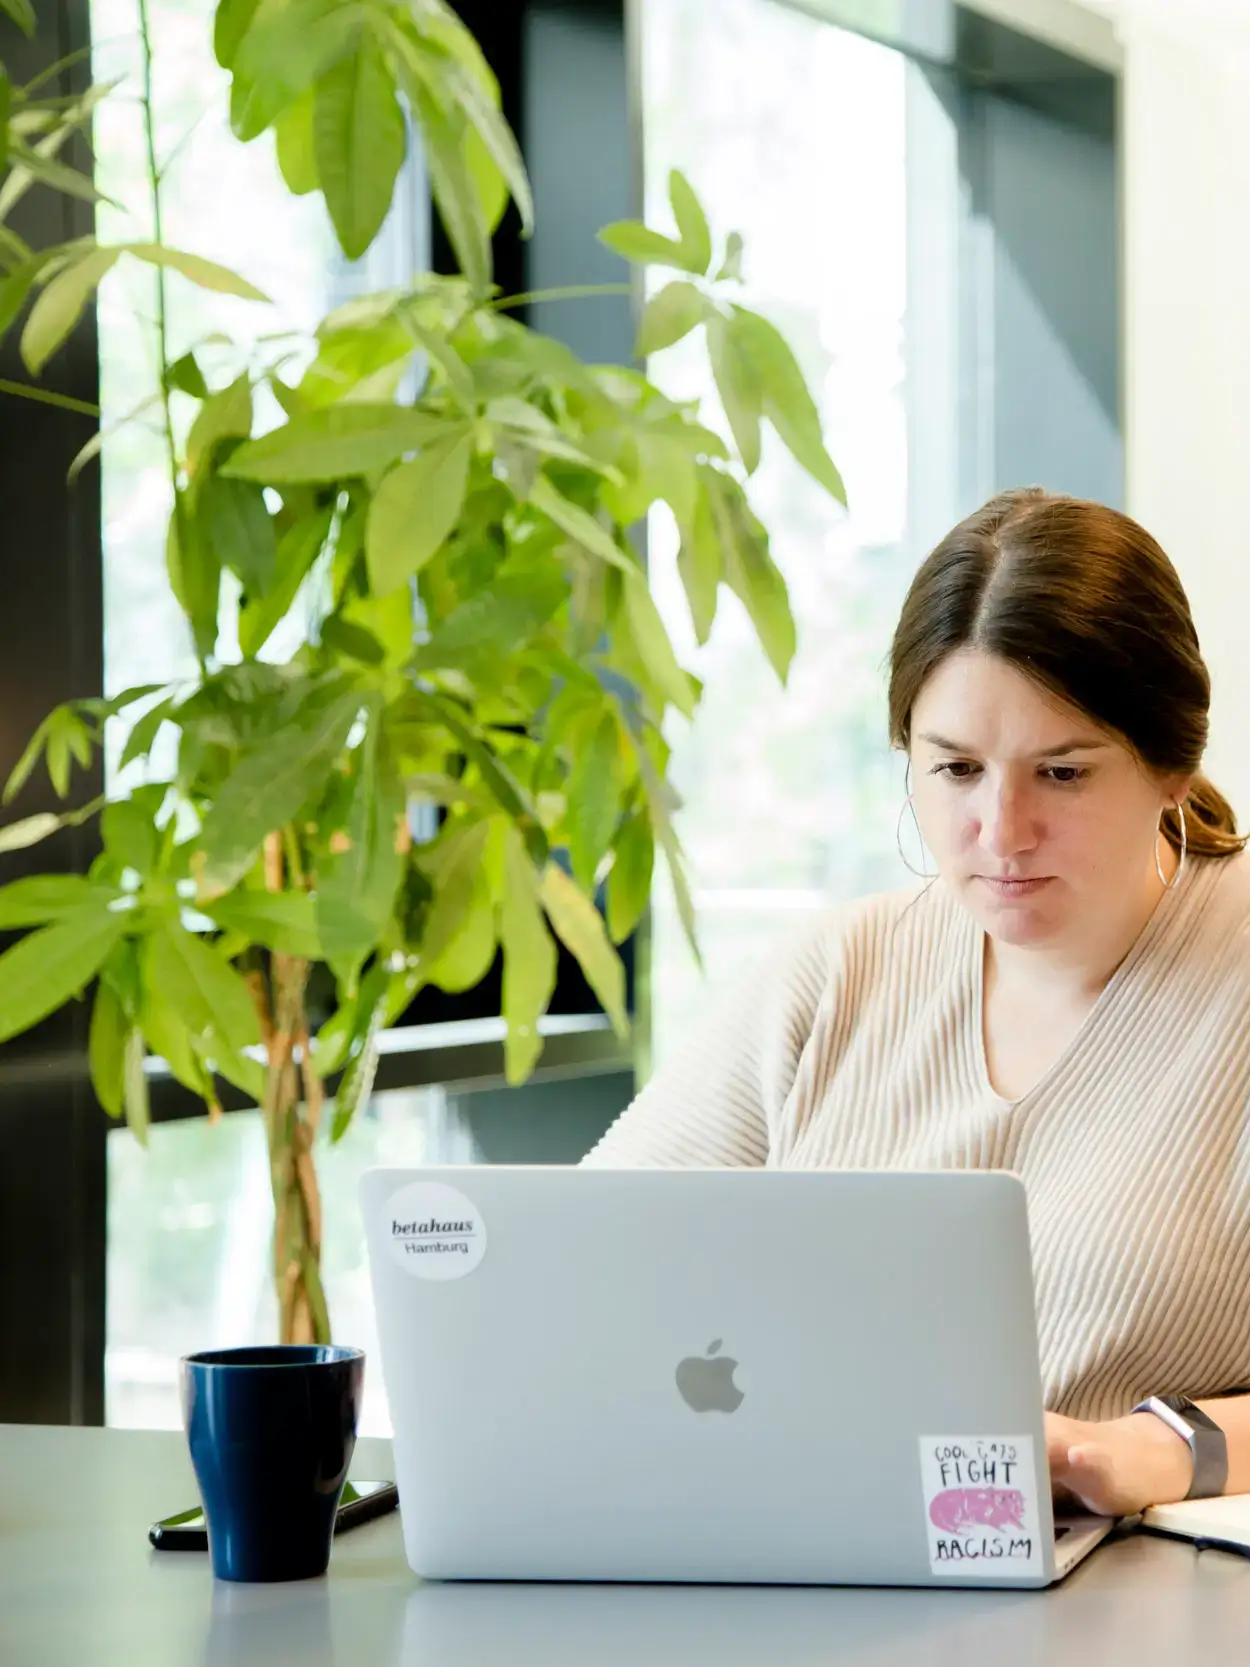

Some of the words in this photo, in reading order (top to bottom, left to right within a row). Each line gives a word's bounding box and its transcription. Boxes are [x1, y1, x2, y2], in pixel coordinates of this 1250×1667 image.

[391, 1218, 473, 1236] betahaus
[404, 1242, 469, 1254] Hamburg
[940, 1460, 1017, 1487] FIGHT
[936, 1539, 1032, 1560] RACISM
